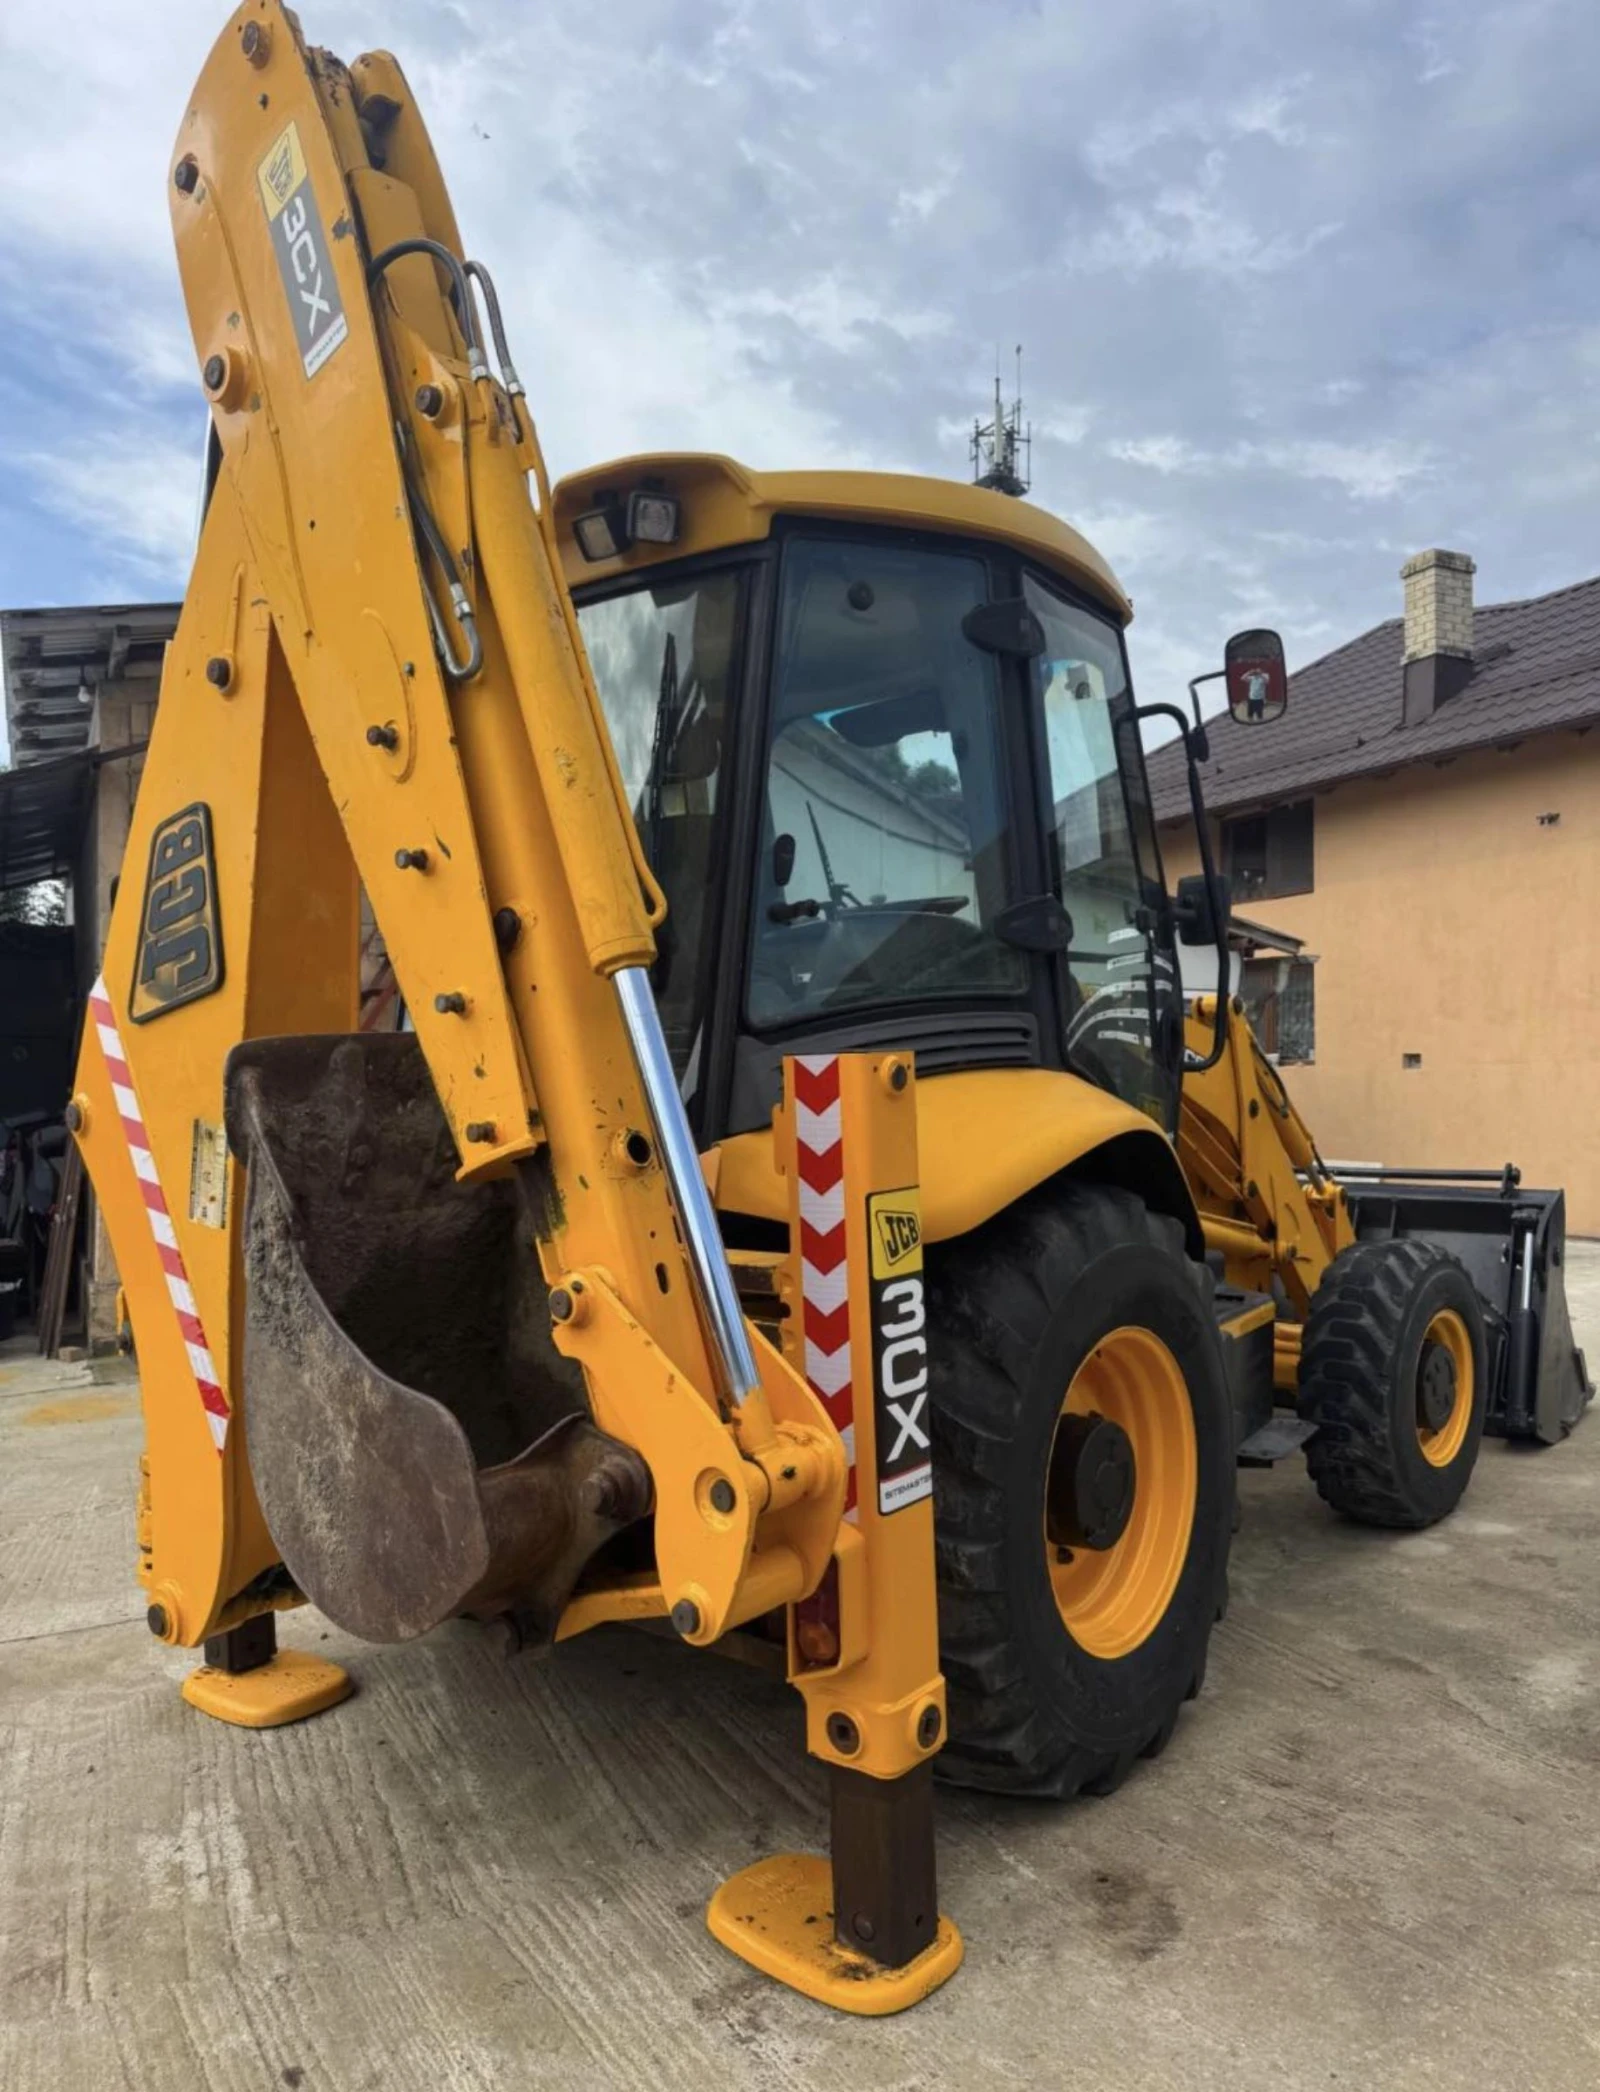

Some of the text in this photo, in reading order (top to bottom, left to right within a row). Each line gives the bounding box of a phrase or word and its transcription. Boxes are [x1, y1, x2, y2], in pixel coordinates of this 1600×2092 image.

[282, 196, 331, 337] 3CX
[139, 819, 211, 986] JCB
[885, 1214, 920, 1258] JCB
[881, 1278, 931, 1463] 3CX
